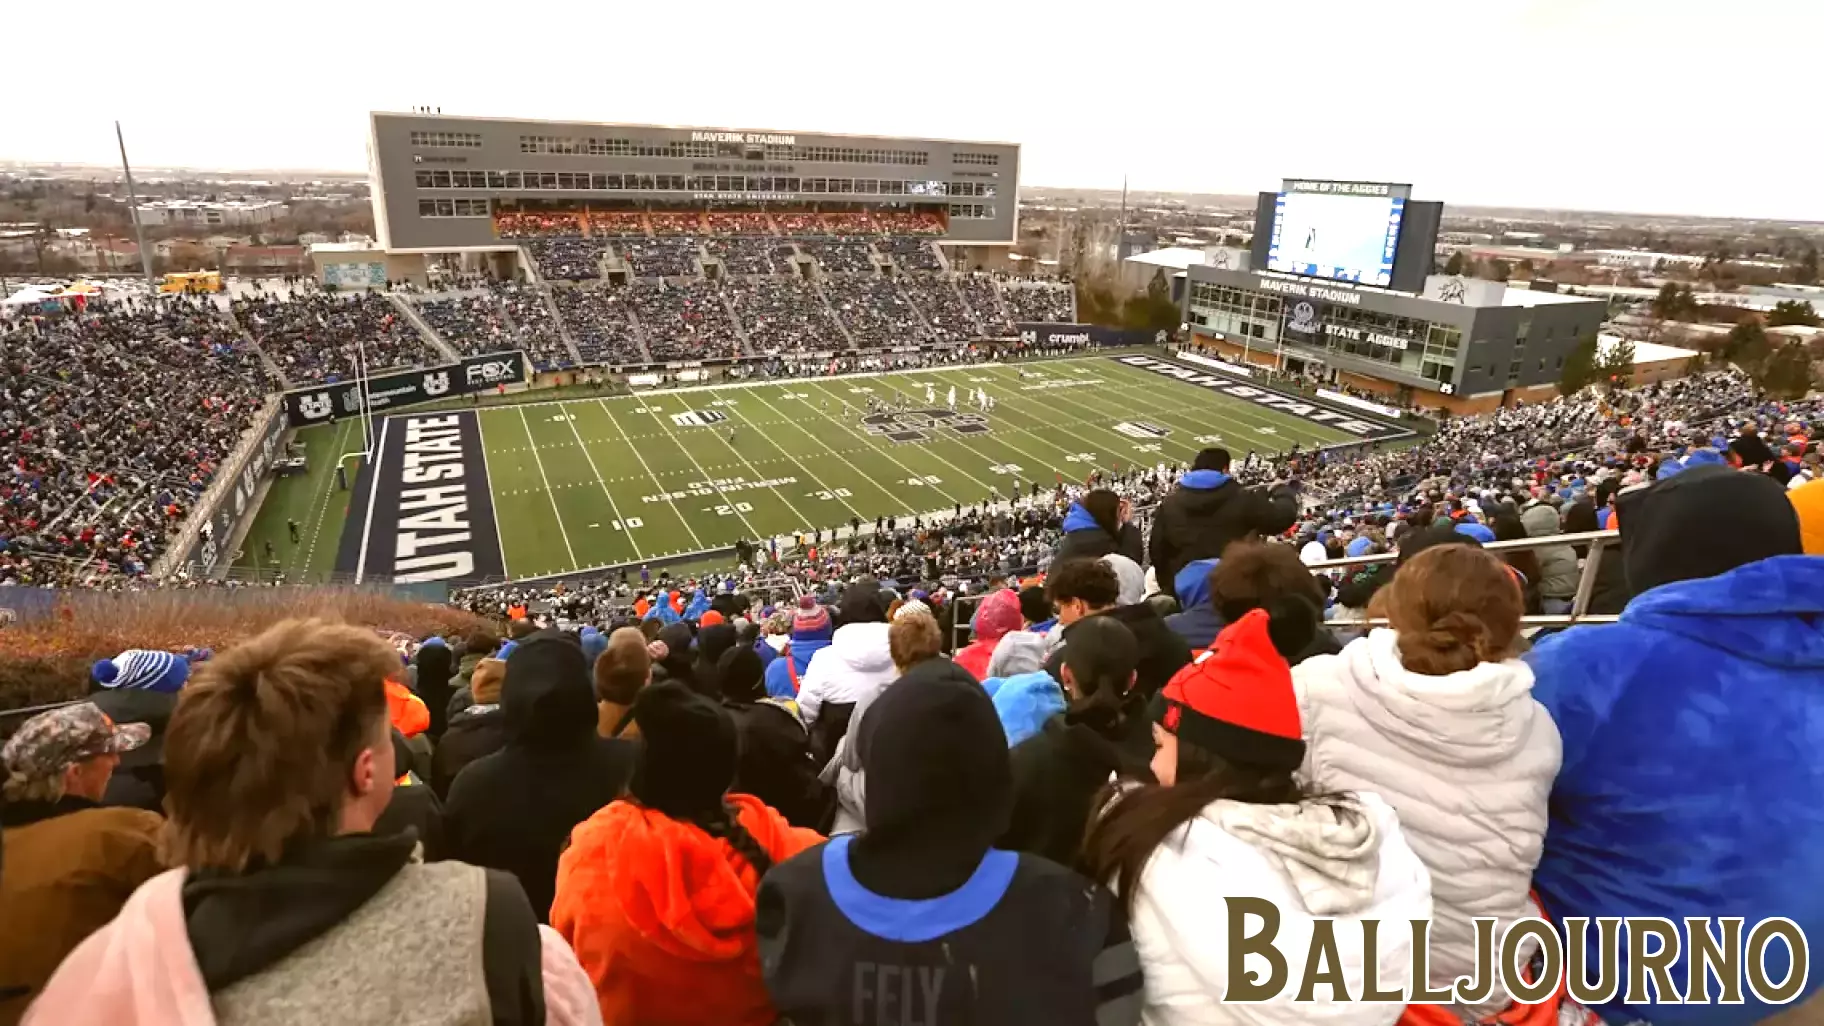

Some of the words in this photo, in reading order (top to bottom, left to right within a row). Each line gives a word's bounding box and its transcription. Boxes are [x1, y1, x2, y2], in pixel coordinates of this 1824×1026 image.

[692, 131, 745, 143] MAVERIK
[746, 133, 796, 145] STADIUM
[1293, 182, 1320, 191] HOME
[1320, 182, 1332, 192] OF
[1332, 183, 1352, 193] THE
[1352, 184, 1388, 195] AGGIES
[1260, 279, 1307, 296] MAVERIK
[1309, 286, 1361, 305] STADIUM
[1049, 332, 1089, 344] crumbl
[1325, 324, 1361, 341] STATE
[1366, 332, 1409, 349] AGGIES
[466, 359, 515, 384] FOX
[1120, 356, 1233, 387] UTAH
[1222, 386, 1387, 434] STATE
[402, 414, 466, 484] STATE
[814, 487, 853, 501] 30
[714, 501, 754, 516] 20
[611, 516, 644, 531] 10
[394, 485, 475, 583] UTAH
